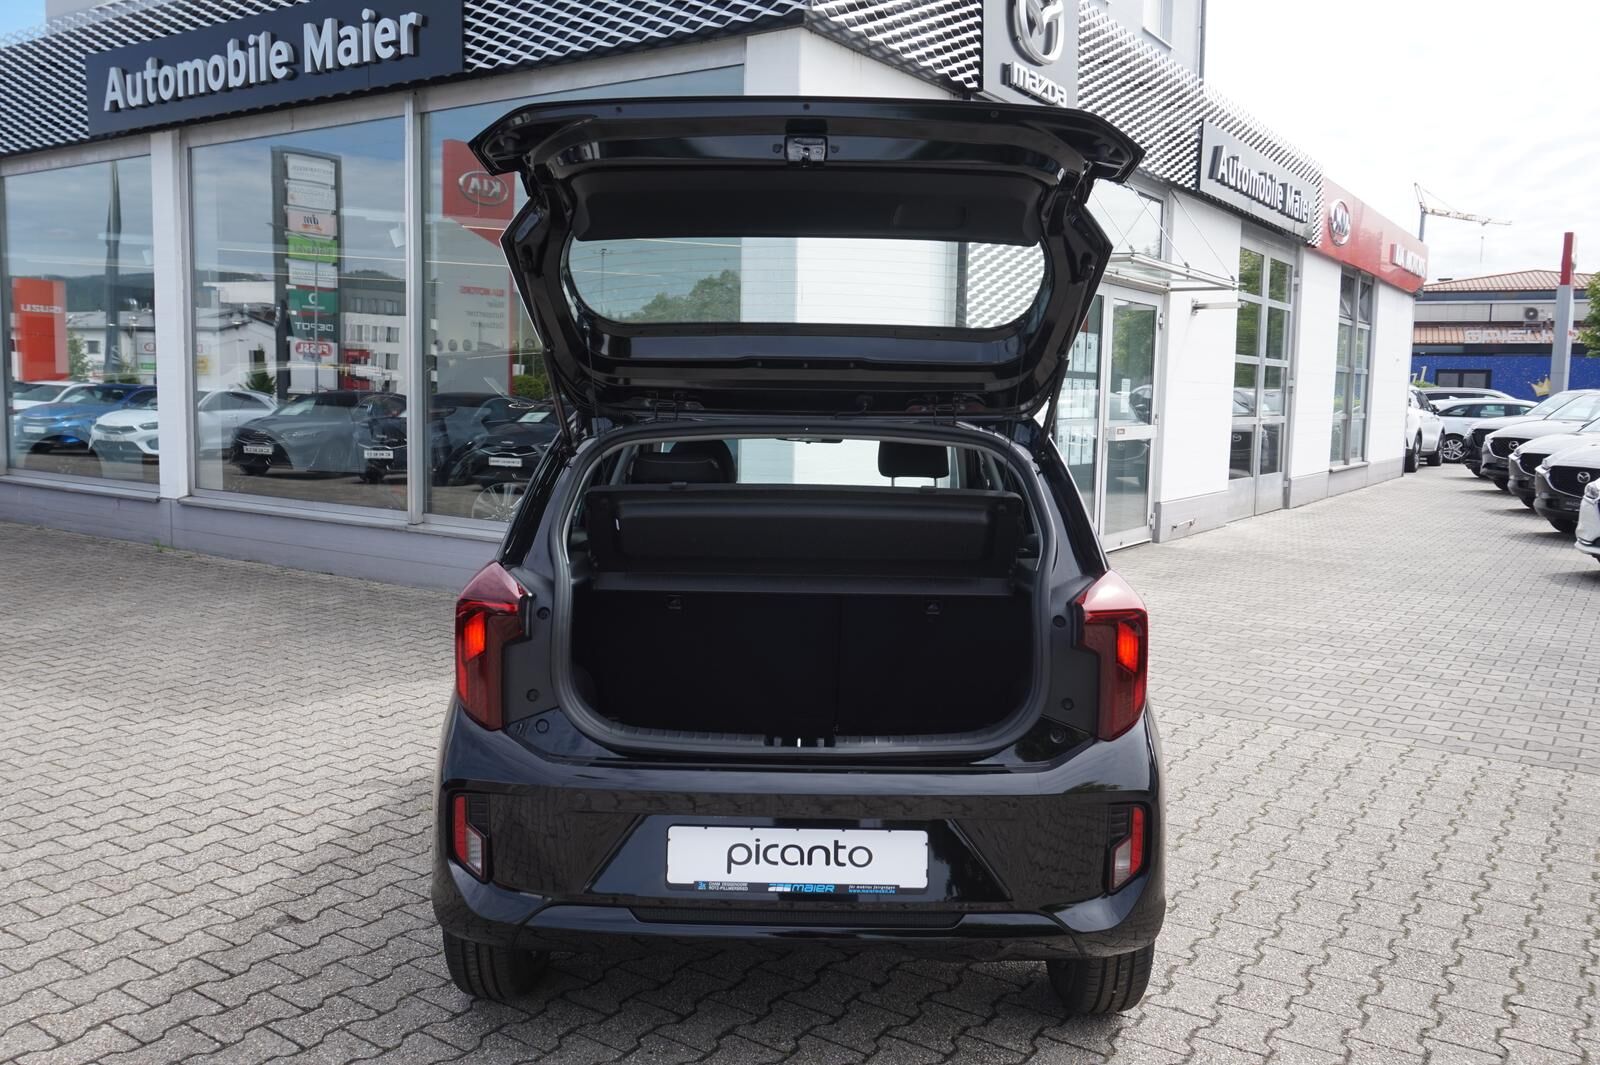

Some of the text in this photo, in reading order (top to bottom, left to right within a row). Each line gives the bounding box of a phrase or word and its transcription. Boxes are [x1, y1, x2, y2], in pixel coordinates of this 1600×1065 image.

[103, 8, 423, 113] Automobile Maier
[1001, 61, 1068, 108] mazda
[1208, 145, 1312, 223] Automobile Maier
[726, 838, 873, 875] picanto
